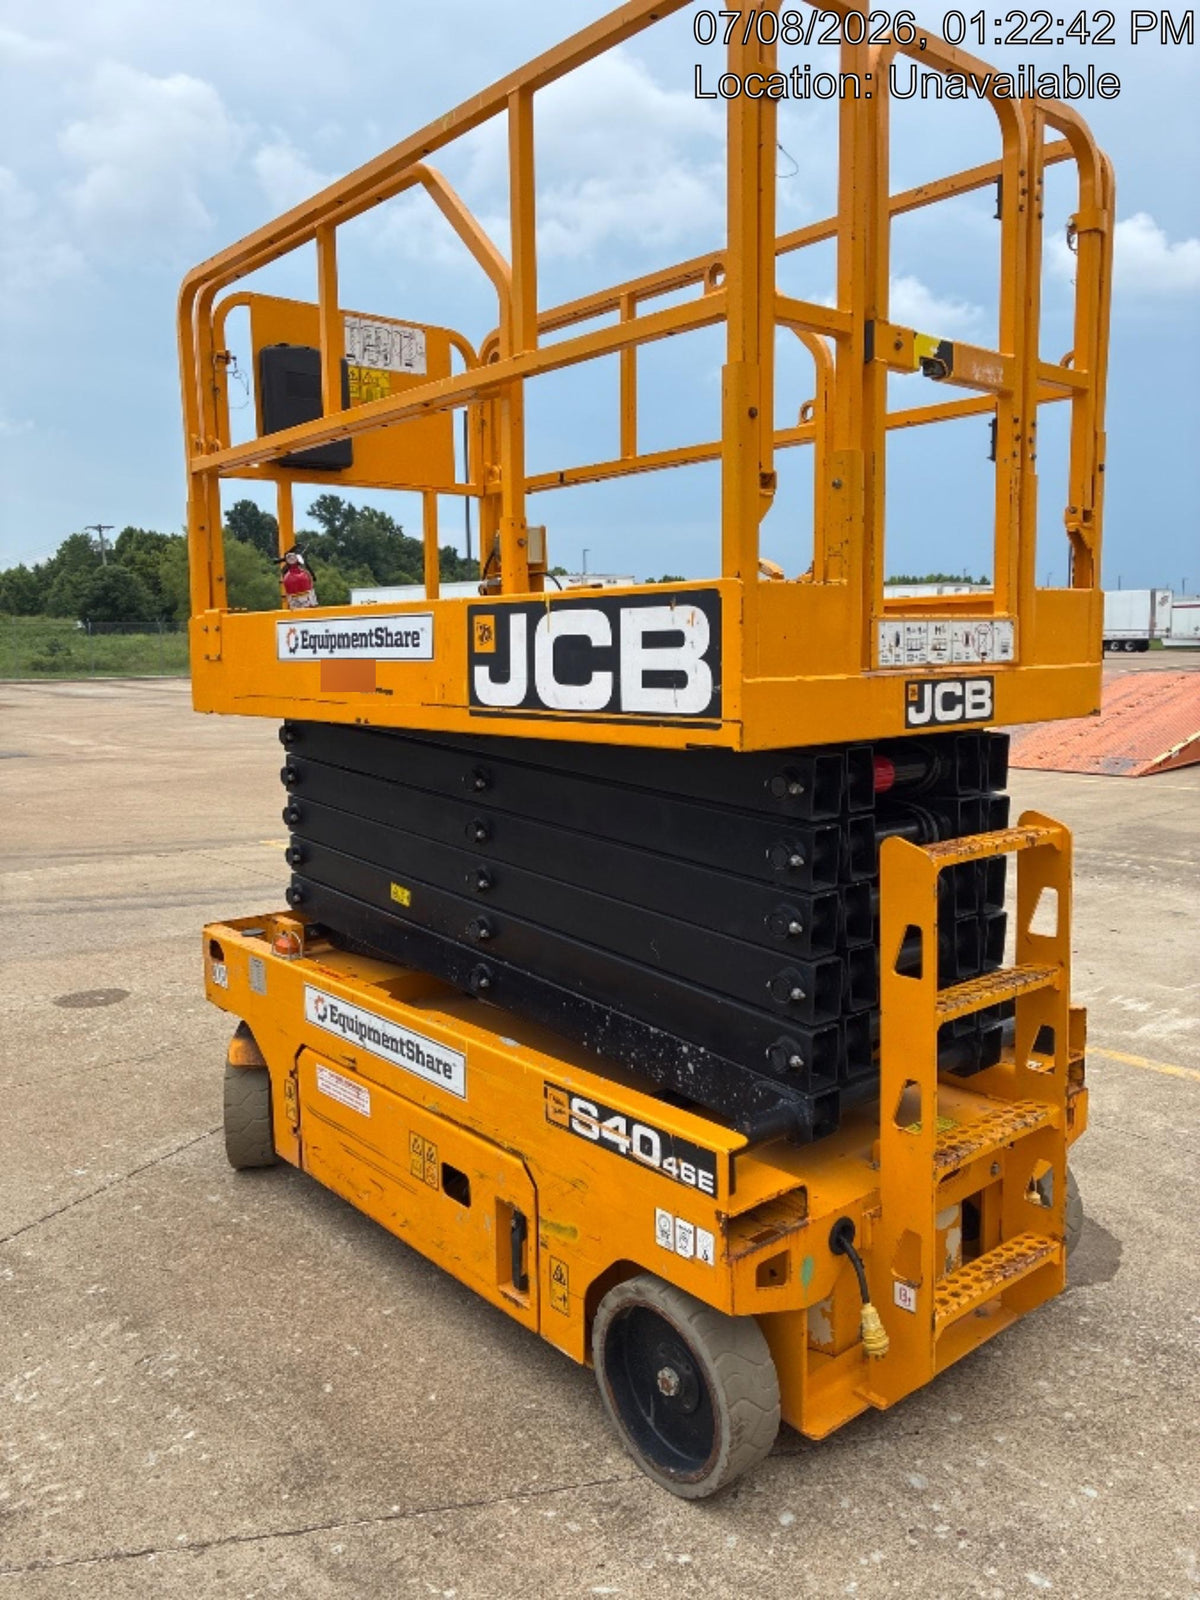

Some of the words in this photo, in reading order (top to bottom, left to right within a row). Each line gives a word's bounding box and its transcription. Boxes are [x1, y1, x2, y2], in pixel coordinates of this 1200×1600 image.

[300, 626, 421, 655] EquipmentShare
[474, 605, 713, 713] JCB
[907, 680, 993, 724] JCB
[329, 1003, 453, 1081] EquipmentShare
